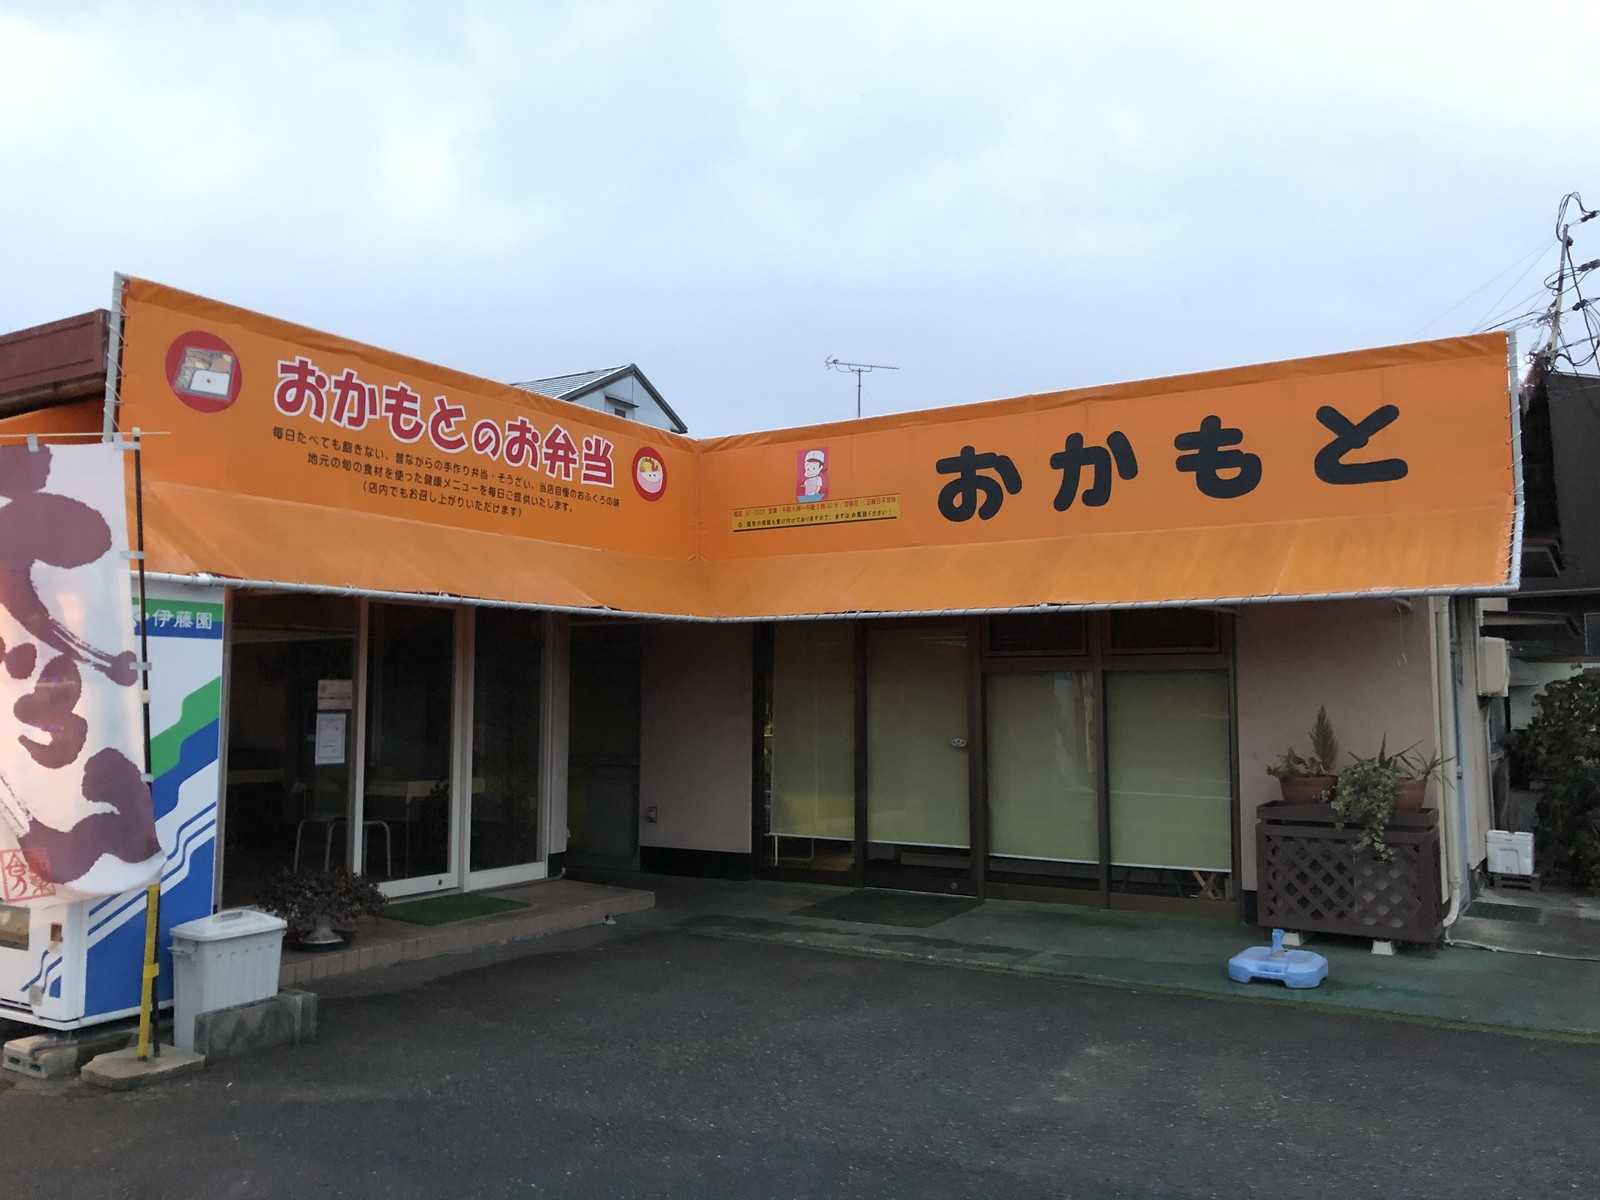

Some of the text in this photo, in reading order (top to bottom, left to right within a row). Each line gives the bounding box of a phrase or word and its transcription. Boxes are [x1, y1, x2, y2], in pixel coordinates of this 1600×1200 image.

[274, 355, 614, 488] おかもとのお弁当
[935, 404, 1408, 522] おかもと
[152, 609, 212, 630] 伊藤園
